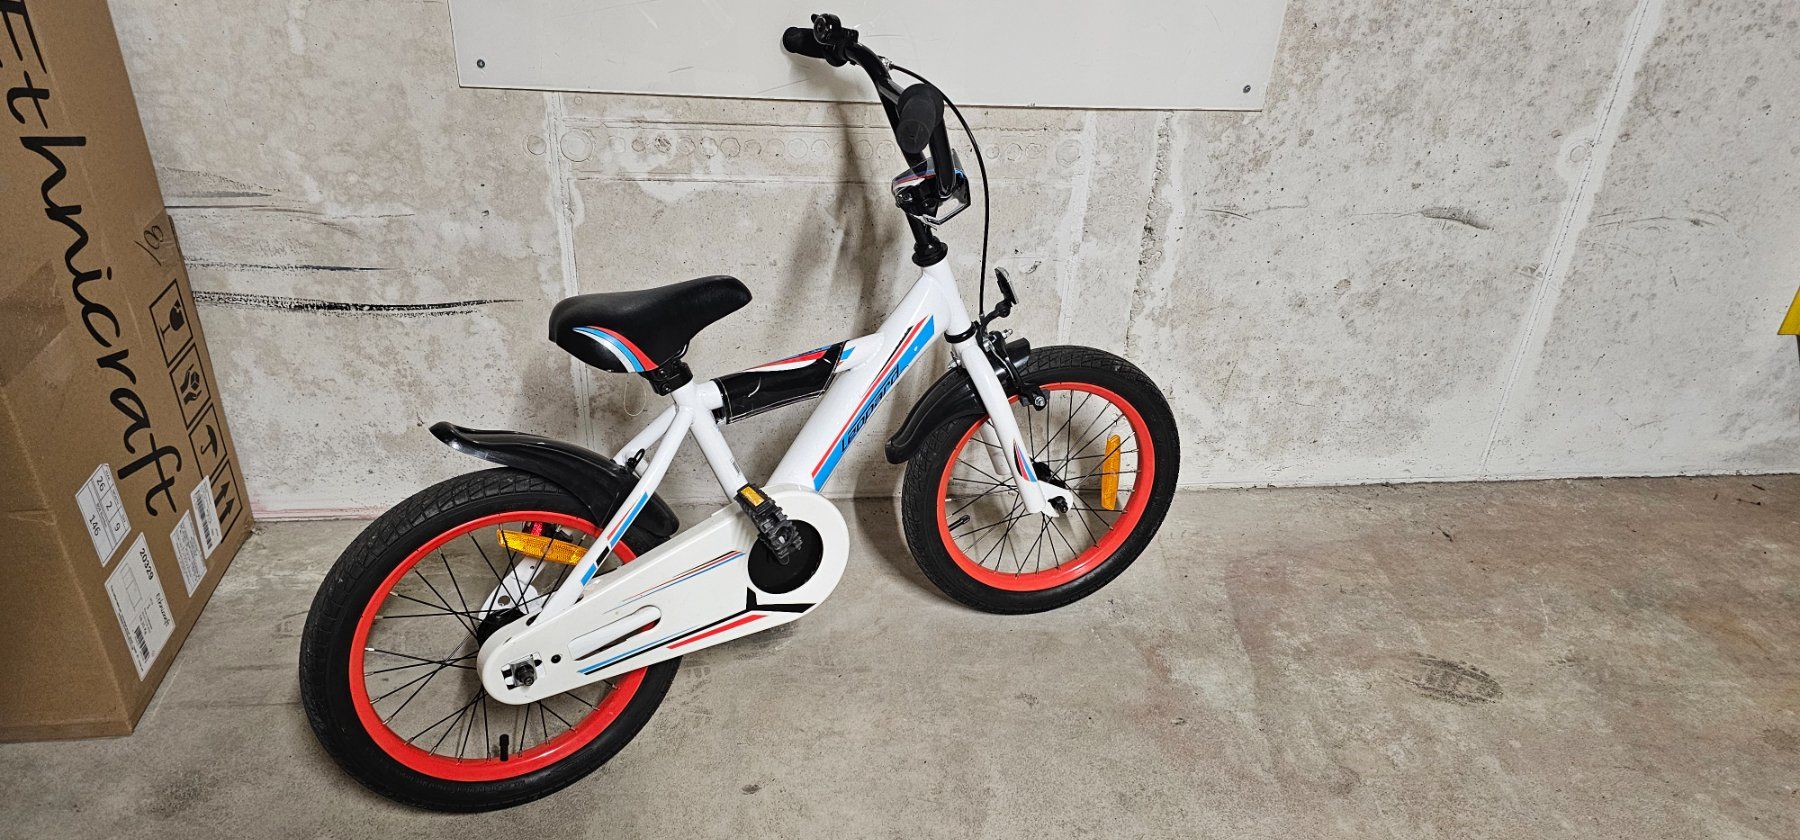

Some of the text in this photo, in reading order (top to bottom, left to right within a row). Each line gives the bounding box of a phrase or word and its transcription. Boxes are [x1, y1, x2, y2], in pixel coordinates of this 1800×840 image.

[96, 475, 121, 532] 26 2 9
[88, 514, 101, 537] 146
[139, 547, 154, 580] 20329
